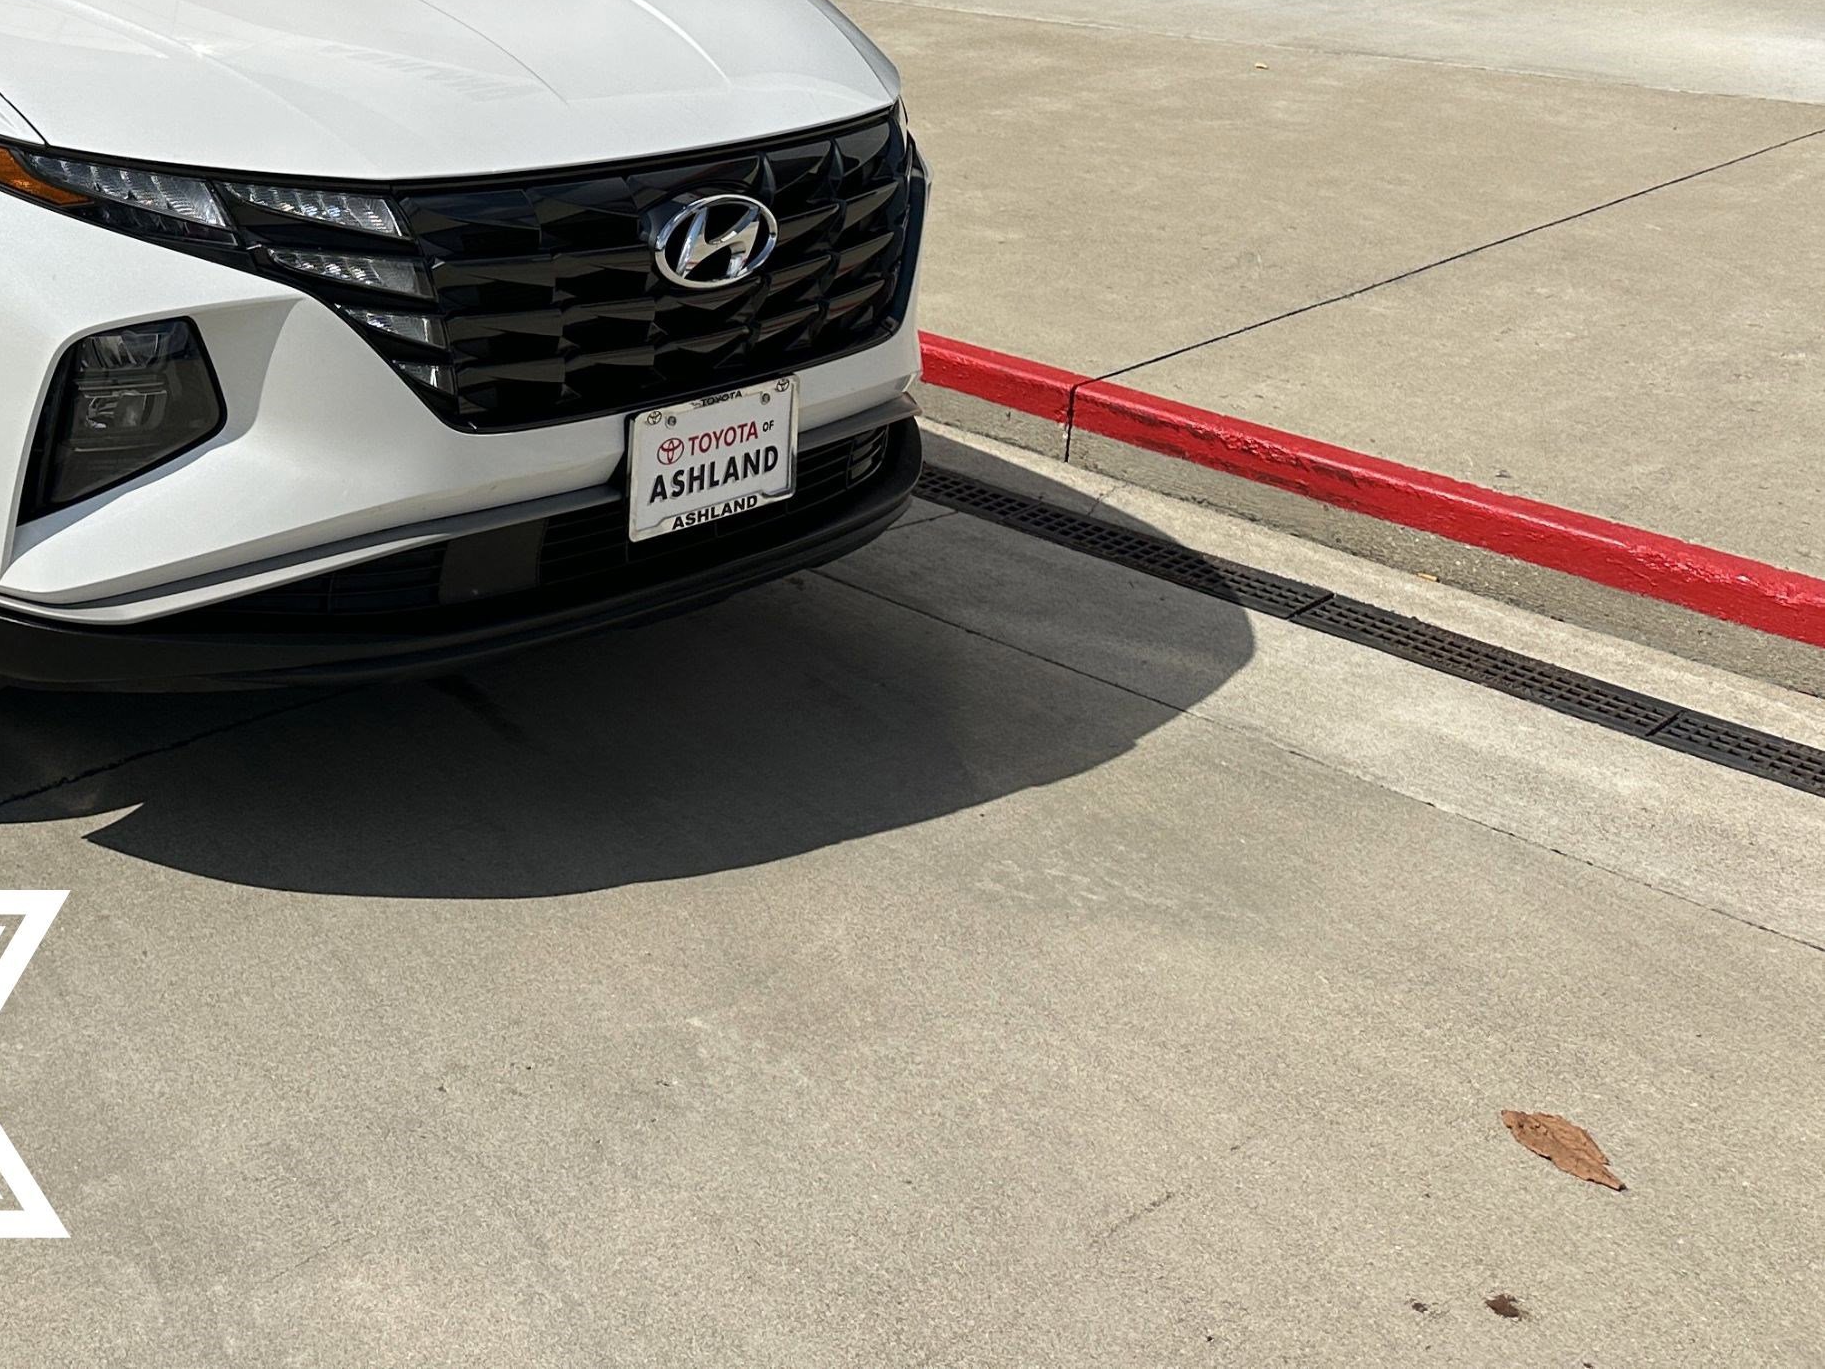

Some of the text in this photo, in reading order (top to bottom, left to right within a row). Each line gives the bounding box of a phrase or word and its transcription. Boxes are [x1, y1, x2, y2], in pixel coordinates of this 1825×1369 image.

[700, 390, 743, 407] TOYOTA
[688, 420, 775, 456] TOYOTA OF
[649, 445, 779, 504] ASHLAND
[671, 494, 758, 530] ASHLAND
